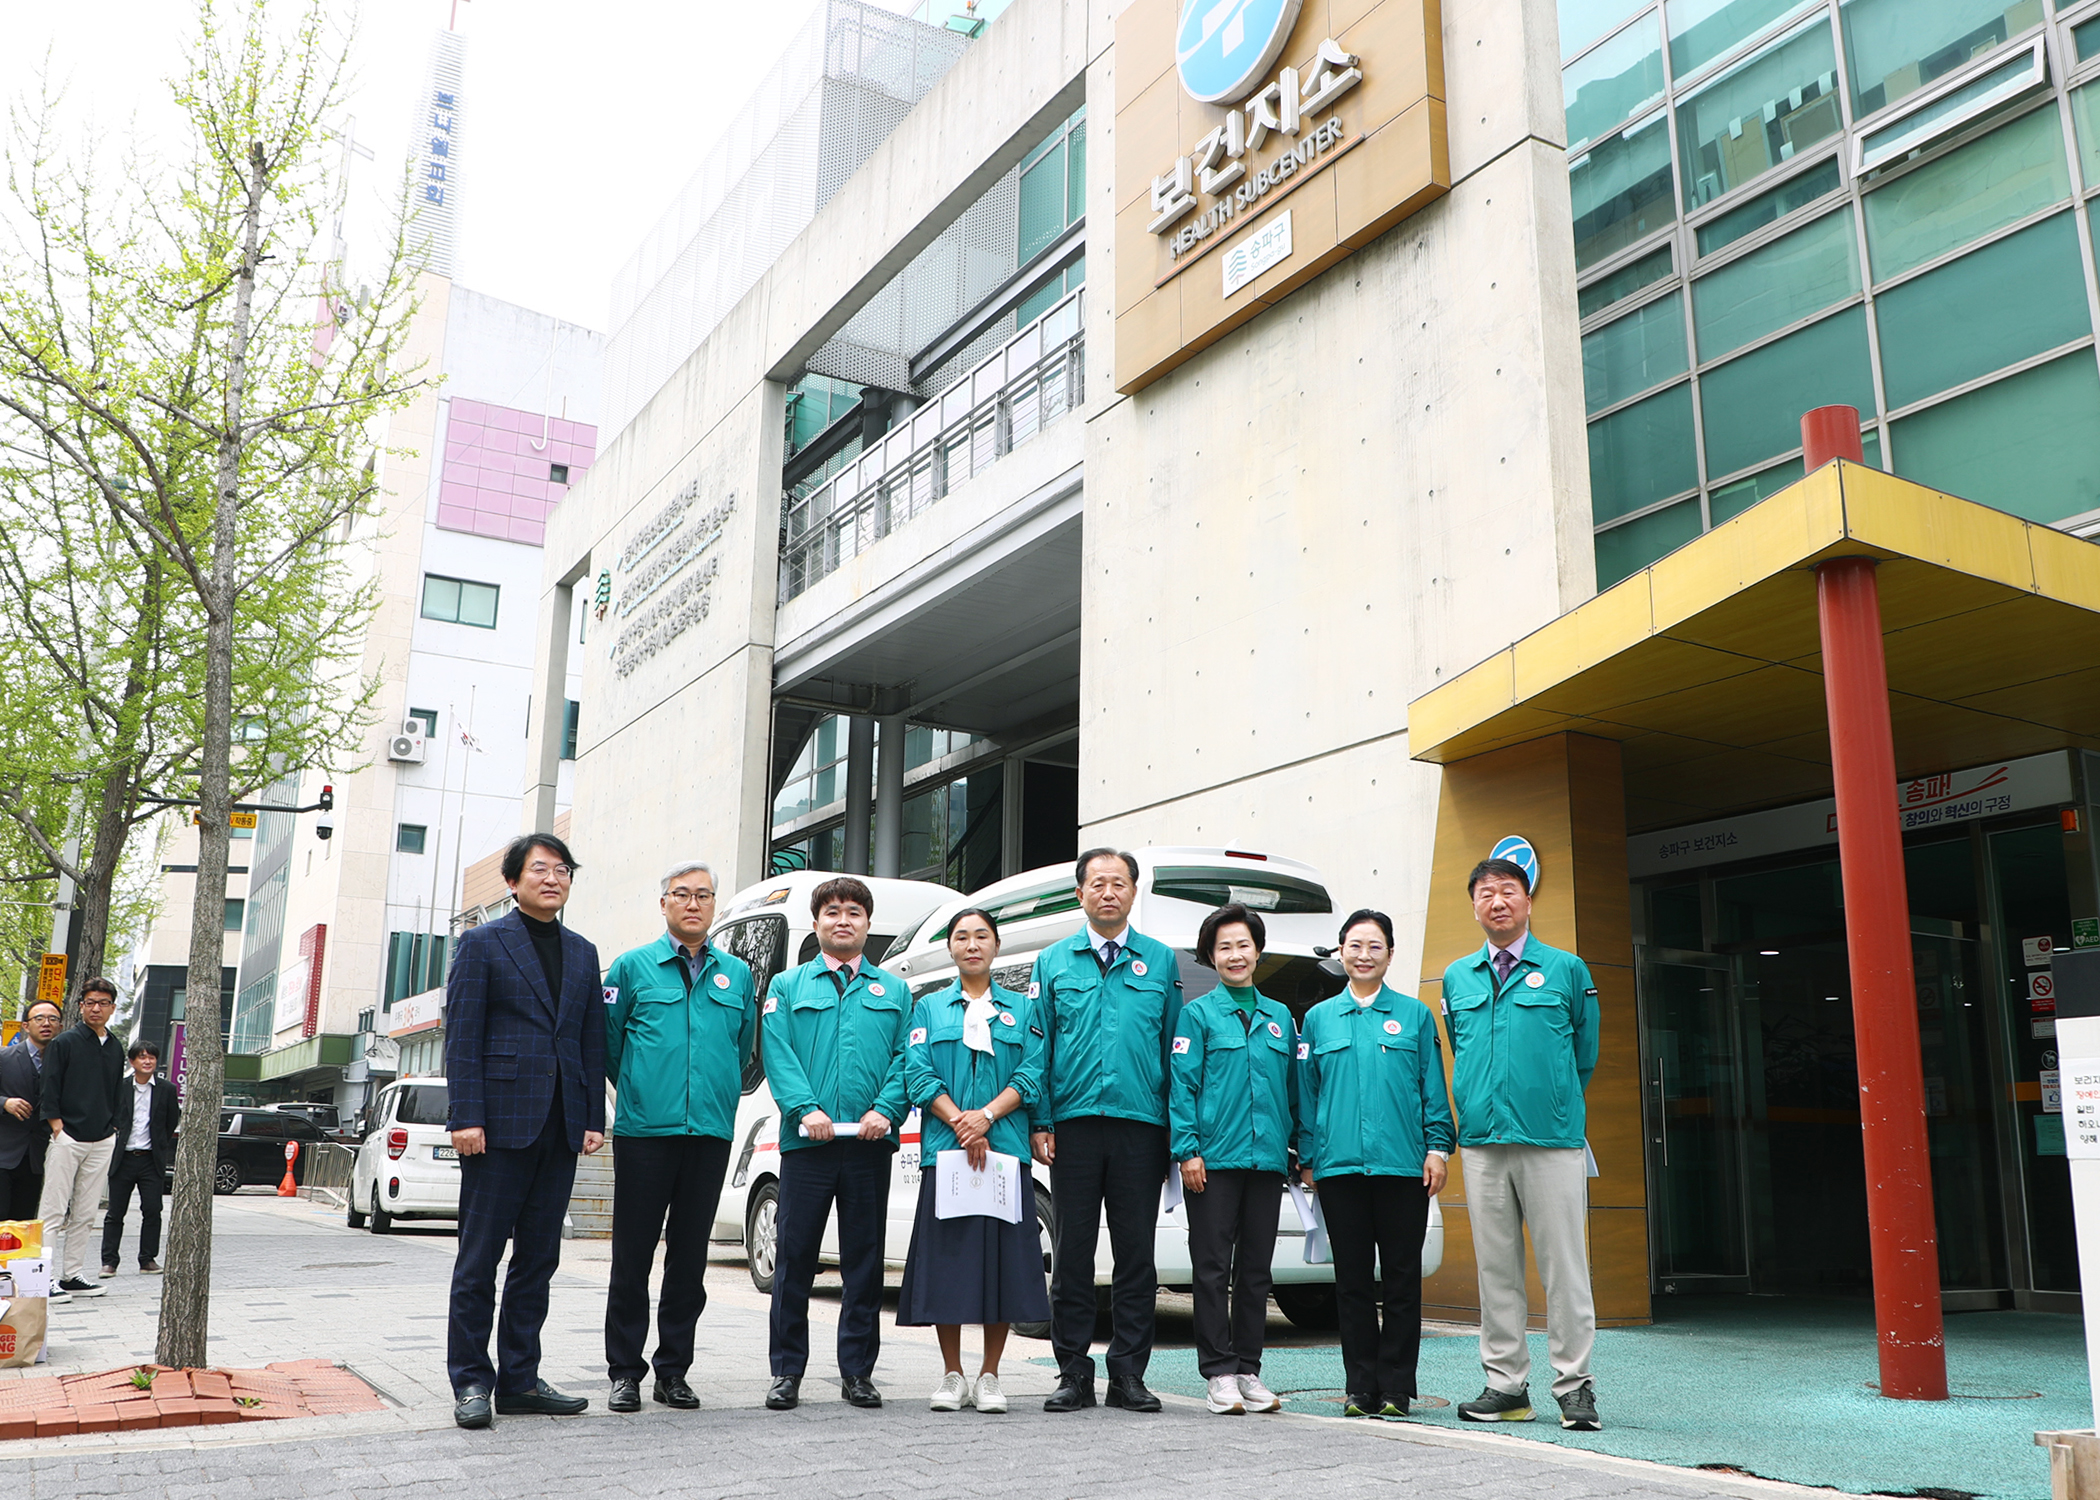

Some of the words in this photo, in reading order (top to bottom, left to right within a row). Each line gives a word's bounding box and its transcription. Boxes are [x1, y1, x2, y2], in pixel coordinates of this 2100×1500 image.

[1147, 37, 1363, 235] 보건지소
[1170, 194, 1234, 260] HEALTH
[1235, 116, 1344, 211] SUBCENTER
[1250, 222, 1285, 259] 송파구
[1906, 774, 1952, 803] 송파!
[1905, 808, 1942, 827] 창의와
[1945, 800, 1982, 818] 혁신의
[1985, 795, 2011, 813] 구정
[1659, 840, 1690, 859] 송파구
[1693, 832, 1738, 851] 보건지소
[2076, 1104, 2095, 1114] 일반
[903, 1174, 910, 1184] 02
[0, 1334, 17, 1342] GER
